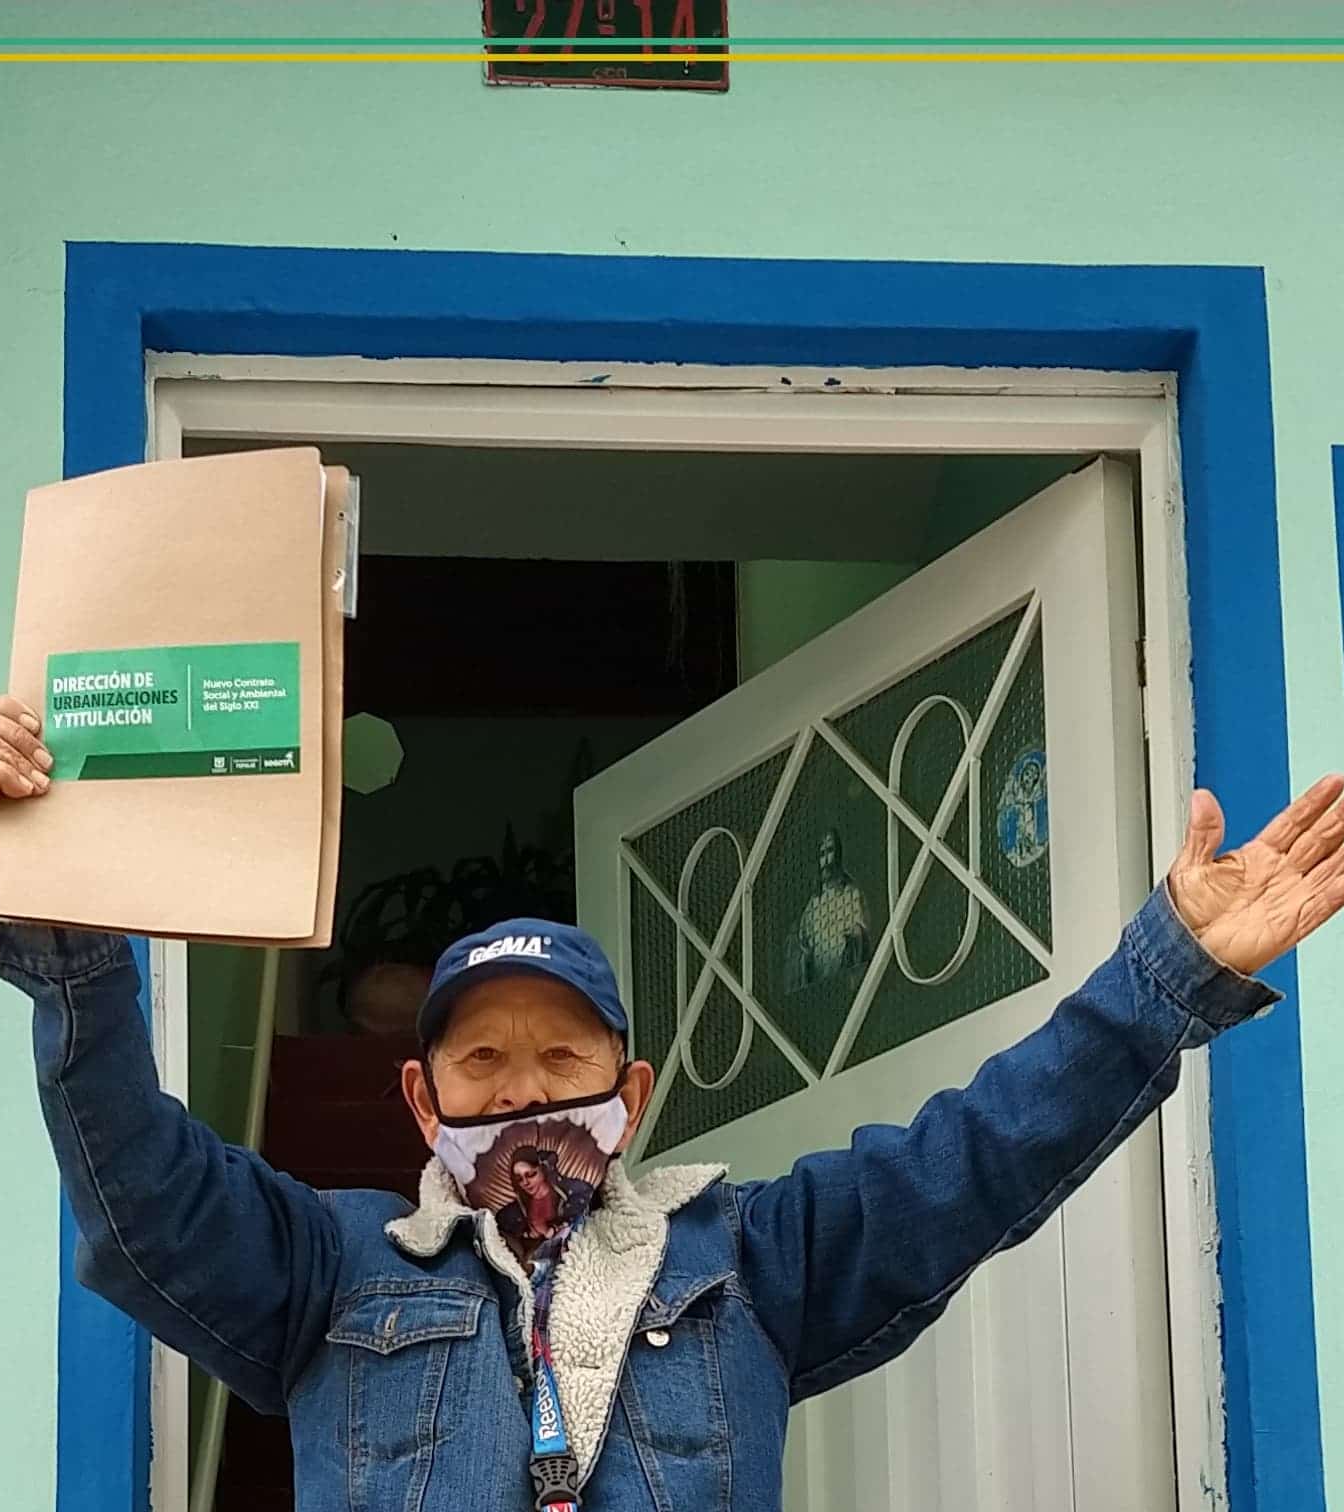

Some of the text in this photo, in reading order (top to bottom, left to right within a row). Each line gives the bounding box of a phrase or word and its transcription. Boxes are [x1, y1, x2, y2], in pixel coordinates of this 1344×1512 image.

[53, 670, 154, 693] DIRECCIÓN DE
[203, 678, 275, 689] Nuevo Contrato
[53, 689, 178, 711] URBANIZACIONES
[203, 688, 287, 700] Social y Ambiental
[203, 701, 258, 712] del Siglo XXI
[54, 705, 153, 729] Y TITULACIÓN
